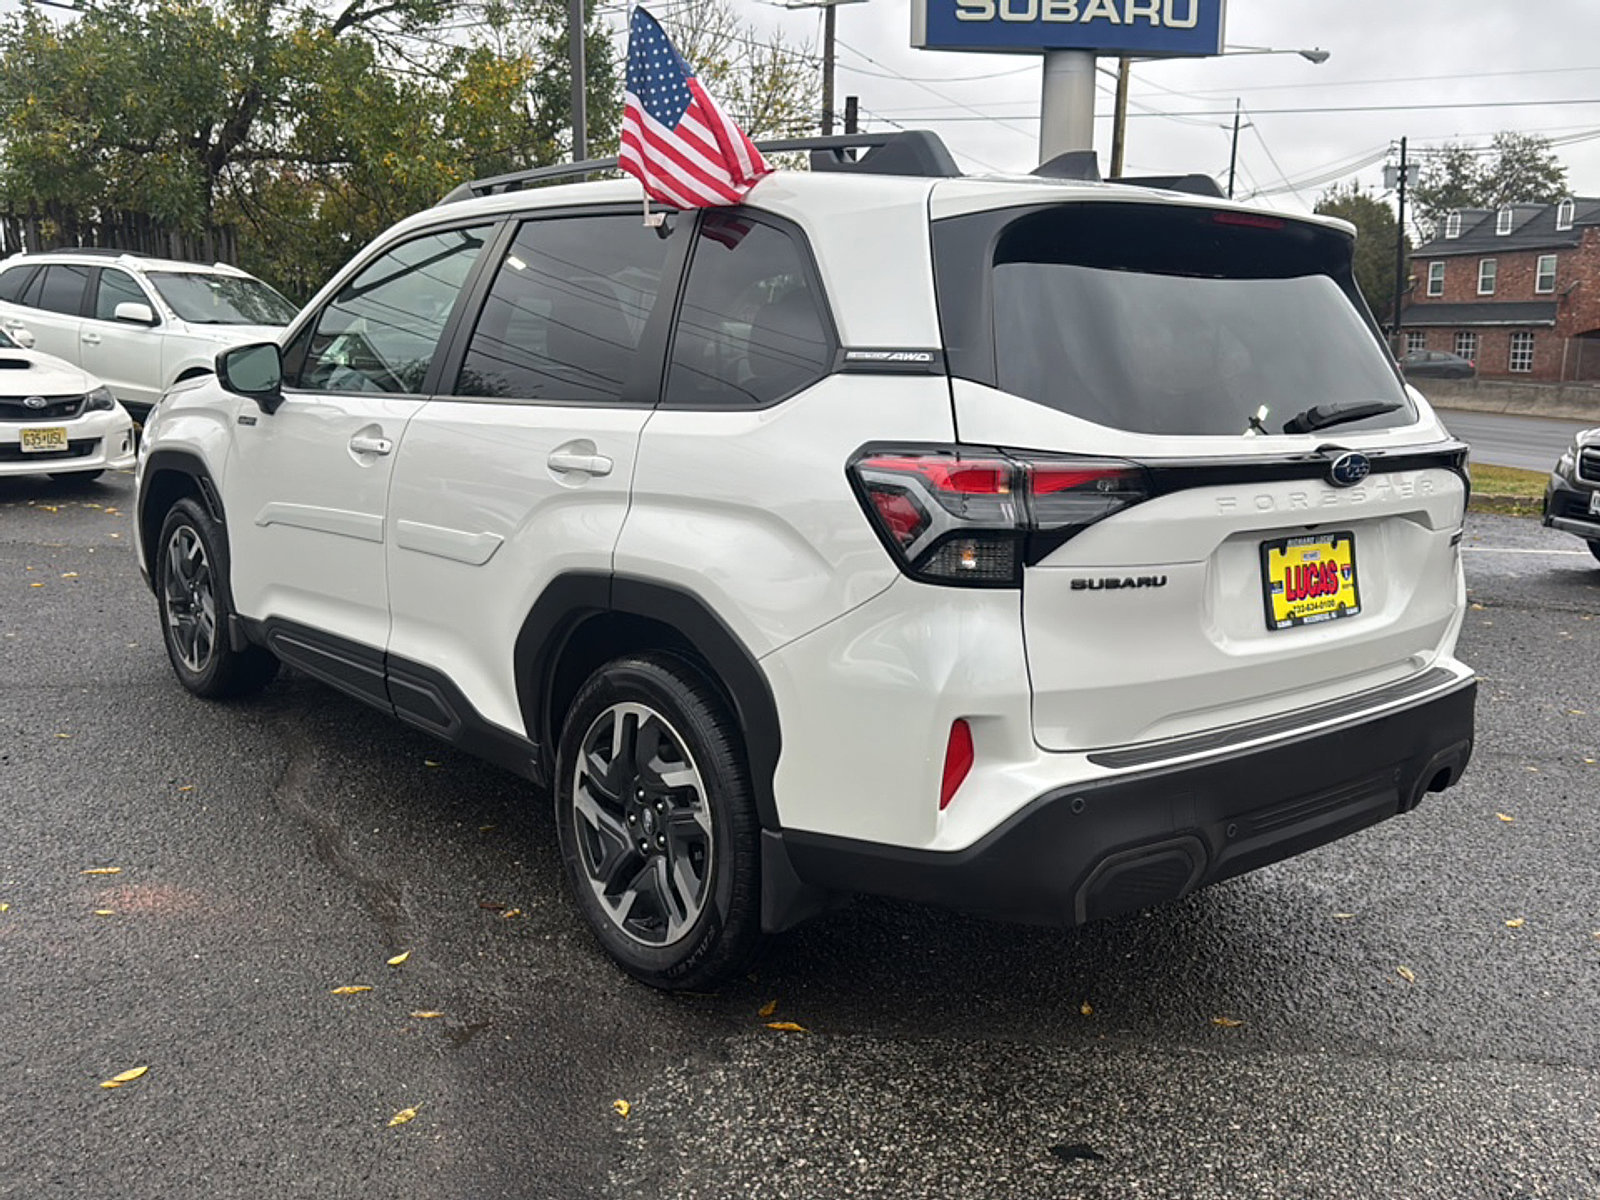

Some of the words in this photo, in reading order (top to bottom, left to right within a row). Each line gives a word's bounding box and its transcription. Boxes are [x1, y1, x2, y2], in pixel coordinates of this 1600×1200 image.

[955, 0, 1198, 28] SUBARU
[1216, 479, 1435, 516] FORESTER
[1070, 575, 1167, 590] SUBARU
[1285, 559, 1338, 602] LUCAS
